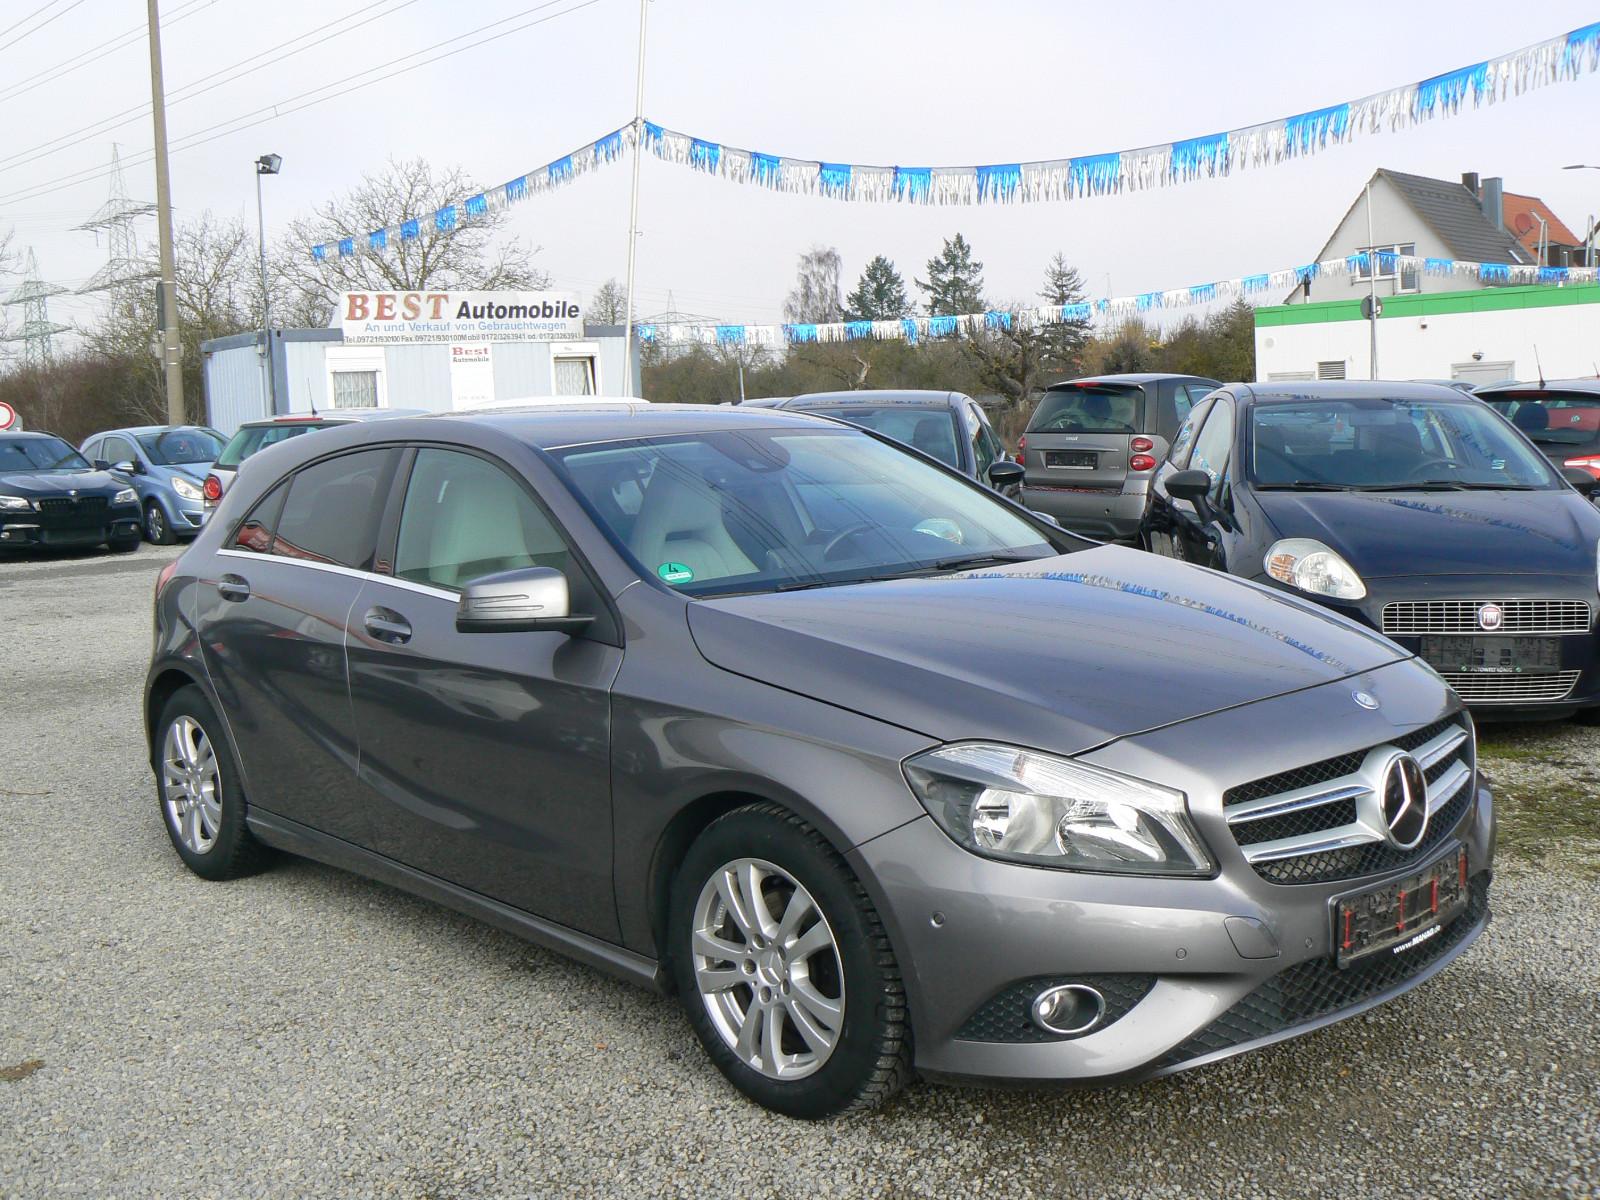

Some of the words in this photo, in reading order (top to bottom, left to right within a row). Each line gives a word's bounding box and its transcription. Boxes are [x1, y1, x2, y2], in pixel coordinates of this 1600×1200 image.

[345, 293, 450, 320] BEST
[456, 300, 580, 320] Automobile
[364, 322, 380, 333] An
[384, 321, 405, 333] und
[408, 321, 451, 332] Verkauf
[455, 323, 476, 332] von
[478, 320, 567, 333] Gebrauchtwagen
[452, 347, 489, 356] Best
[668, 563, 679, 573] 4
